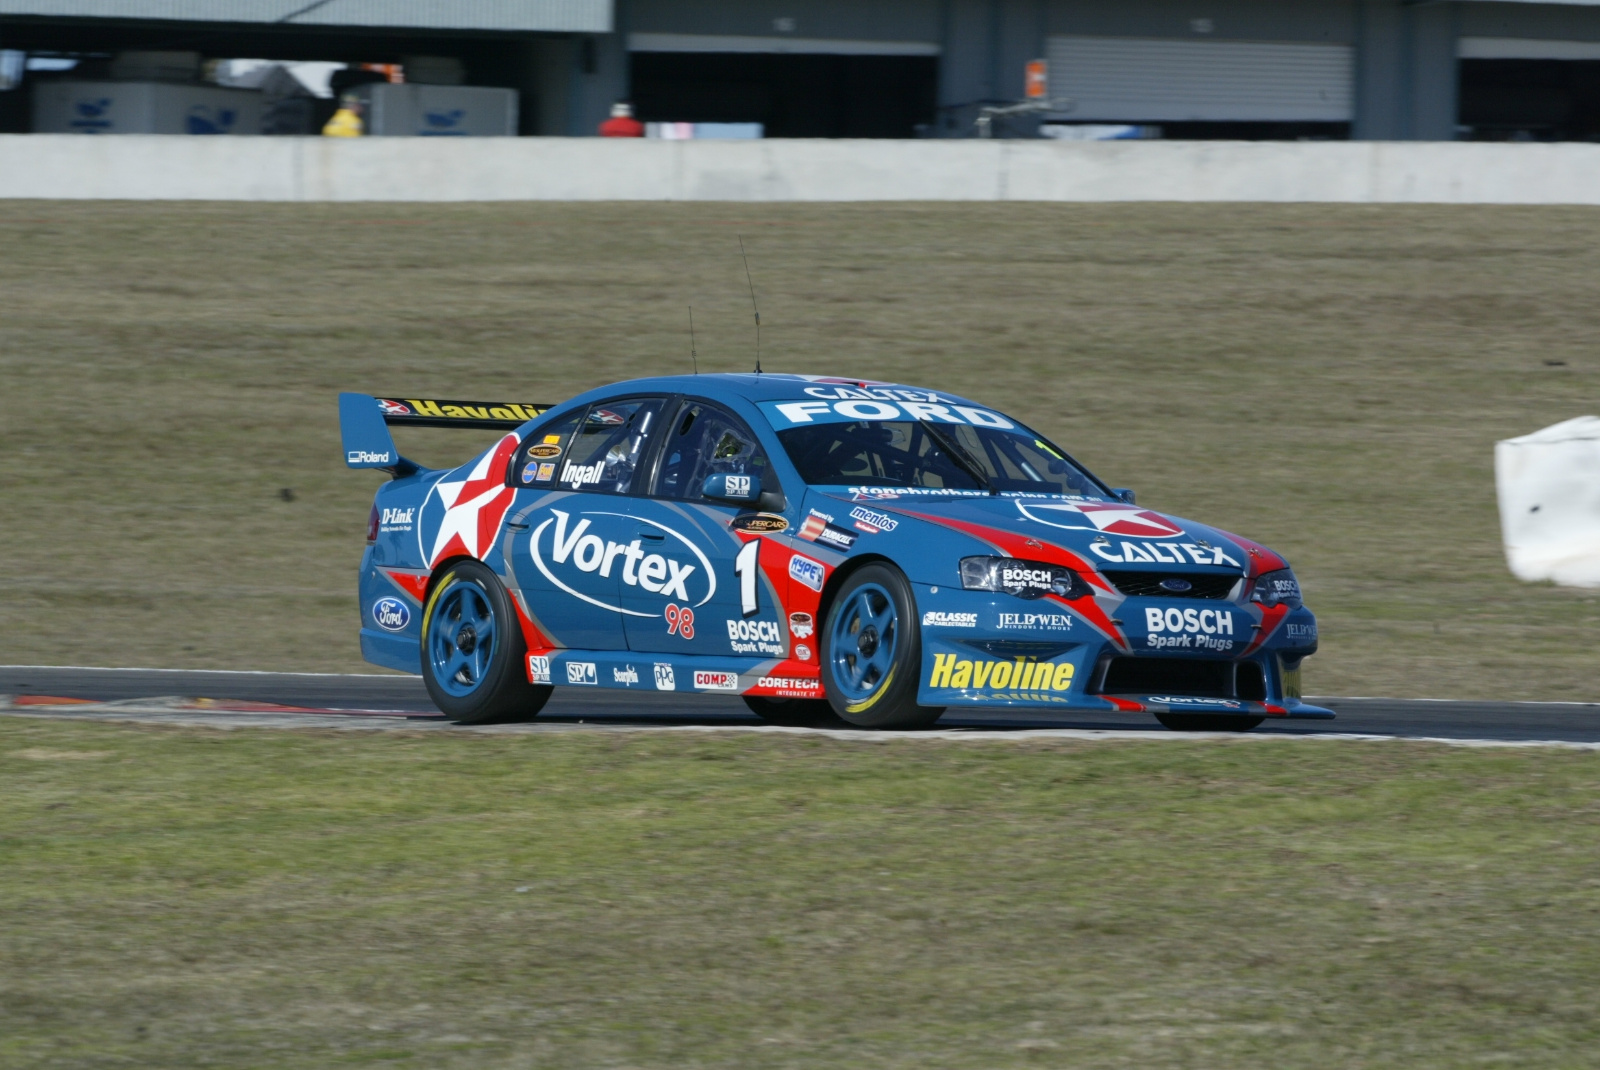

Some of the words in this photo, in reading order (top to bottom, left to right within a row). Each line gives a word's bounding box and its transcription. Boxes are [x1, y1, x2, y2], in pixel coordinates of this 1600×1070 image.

[804, 387, 956, 404] CALTEX
[775, 400, 1014, 429] FORD
[360, 451, 389, 462] Roland
[560, 459, 605, 489] Ingall
[727, 477, 748, 489] SP
[382, 508, 413, 524] D-Link
[852, 507, 896, 531] mentos
[821, 528, 852, 544] DURACELL
[550, 508, 695, 601] Vortex
[1089, 541, 1241, 567] CALTEX
[735, 537, 761, 618] 1
[791, 557, 819, 580] HYPE
[1003, 569, 1051, 582] BOSCH
[1003, 580, 1027, 588] Spark
[1029, 581, 1051, 589] Plugs
[380, 601, 402, 626] Ford
[664, 603, 694, 640] 98
[935, 612, 977, 623] CLASSIC
[1145, 608, 1233, 635] BOSCH
[727, 620, 780, 641] BOSCH
[730, 641, 758, 654] Spark
[759, 642, 784, 655] Plugs
[1147, 633, 1191, 649] Spark
[1195, 634, 1233, 651] Plugs
[531, 657, 548, 673] SP
[568, 664, 584, 682] SP
[929, 653, 1075, 691] Havoline
[655, 666, 673, 686] PPG
[696, 674, 727, 685] COMP
[757, 677, 819, 689] CORETECH
